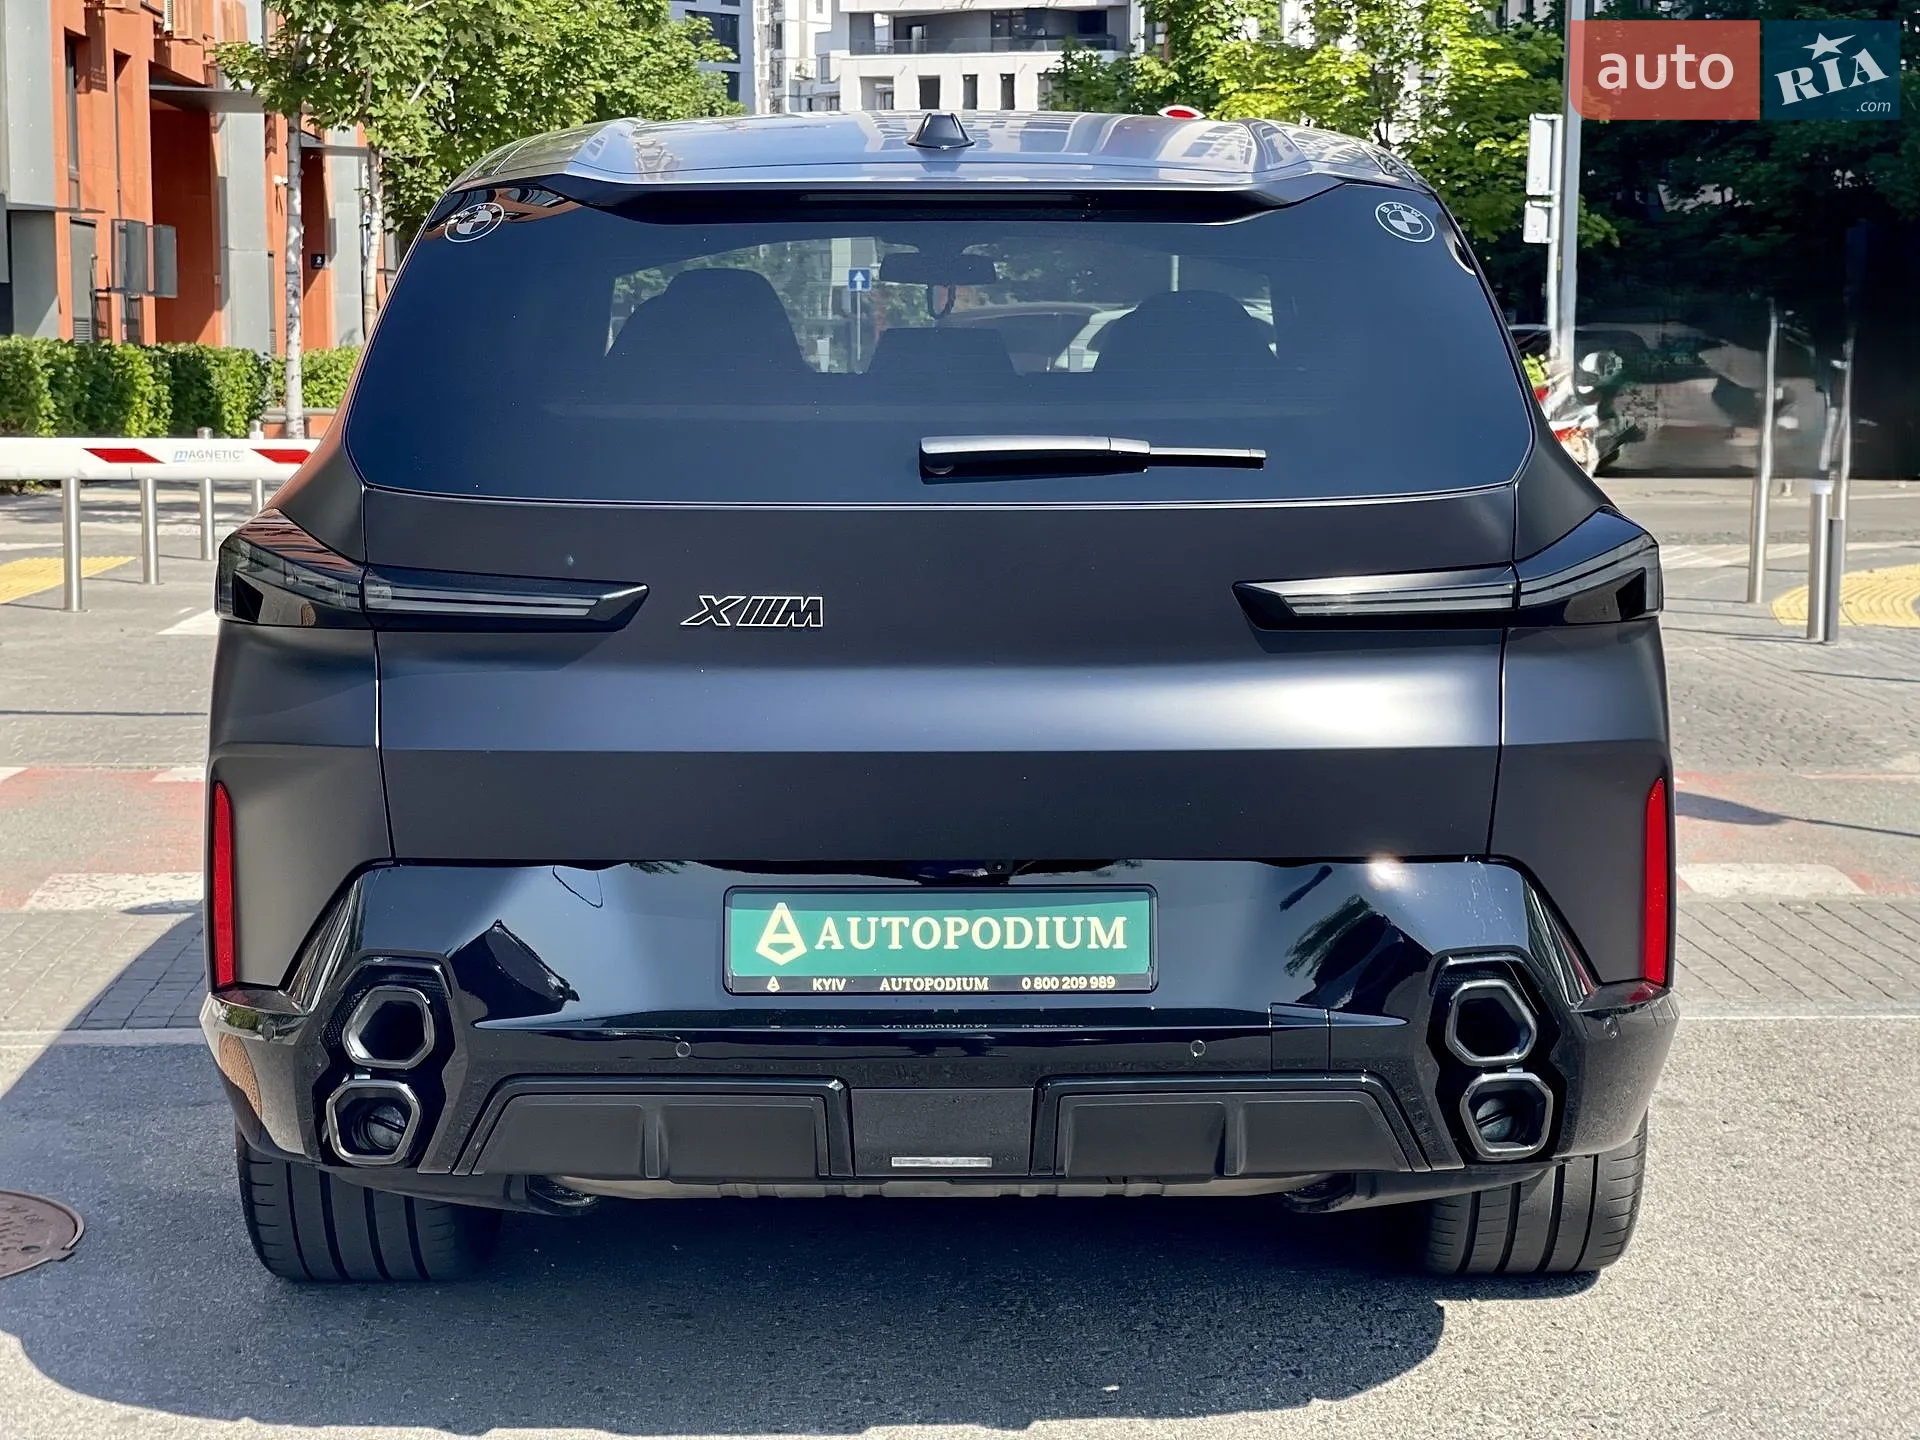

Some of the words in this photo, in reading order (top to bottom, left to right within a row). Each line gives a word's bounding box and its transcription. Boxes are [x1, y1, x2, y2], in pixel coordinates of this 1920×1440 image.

[1380, 203, 1421, 218] BMW
[814, 916, 1128, 950] AUTOPODIUM
[812, 977, 847, 992] KYIV
[879, 977, 990, 992] AUTOPODIUM
[1021, 977, 1031, 990] 0
[1033, 977, 1060, 990] 800
[1061, 977, 1088, 990] 209
[1090, 976, 1116, 989] 989
